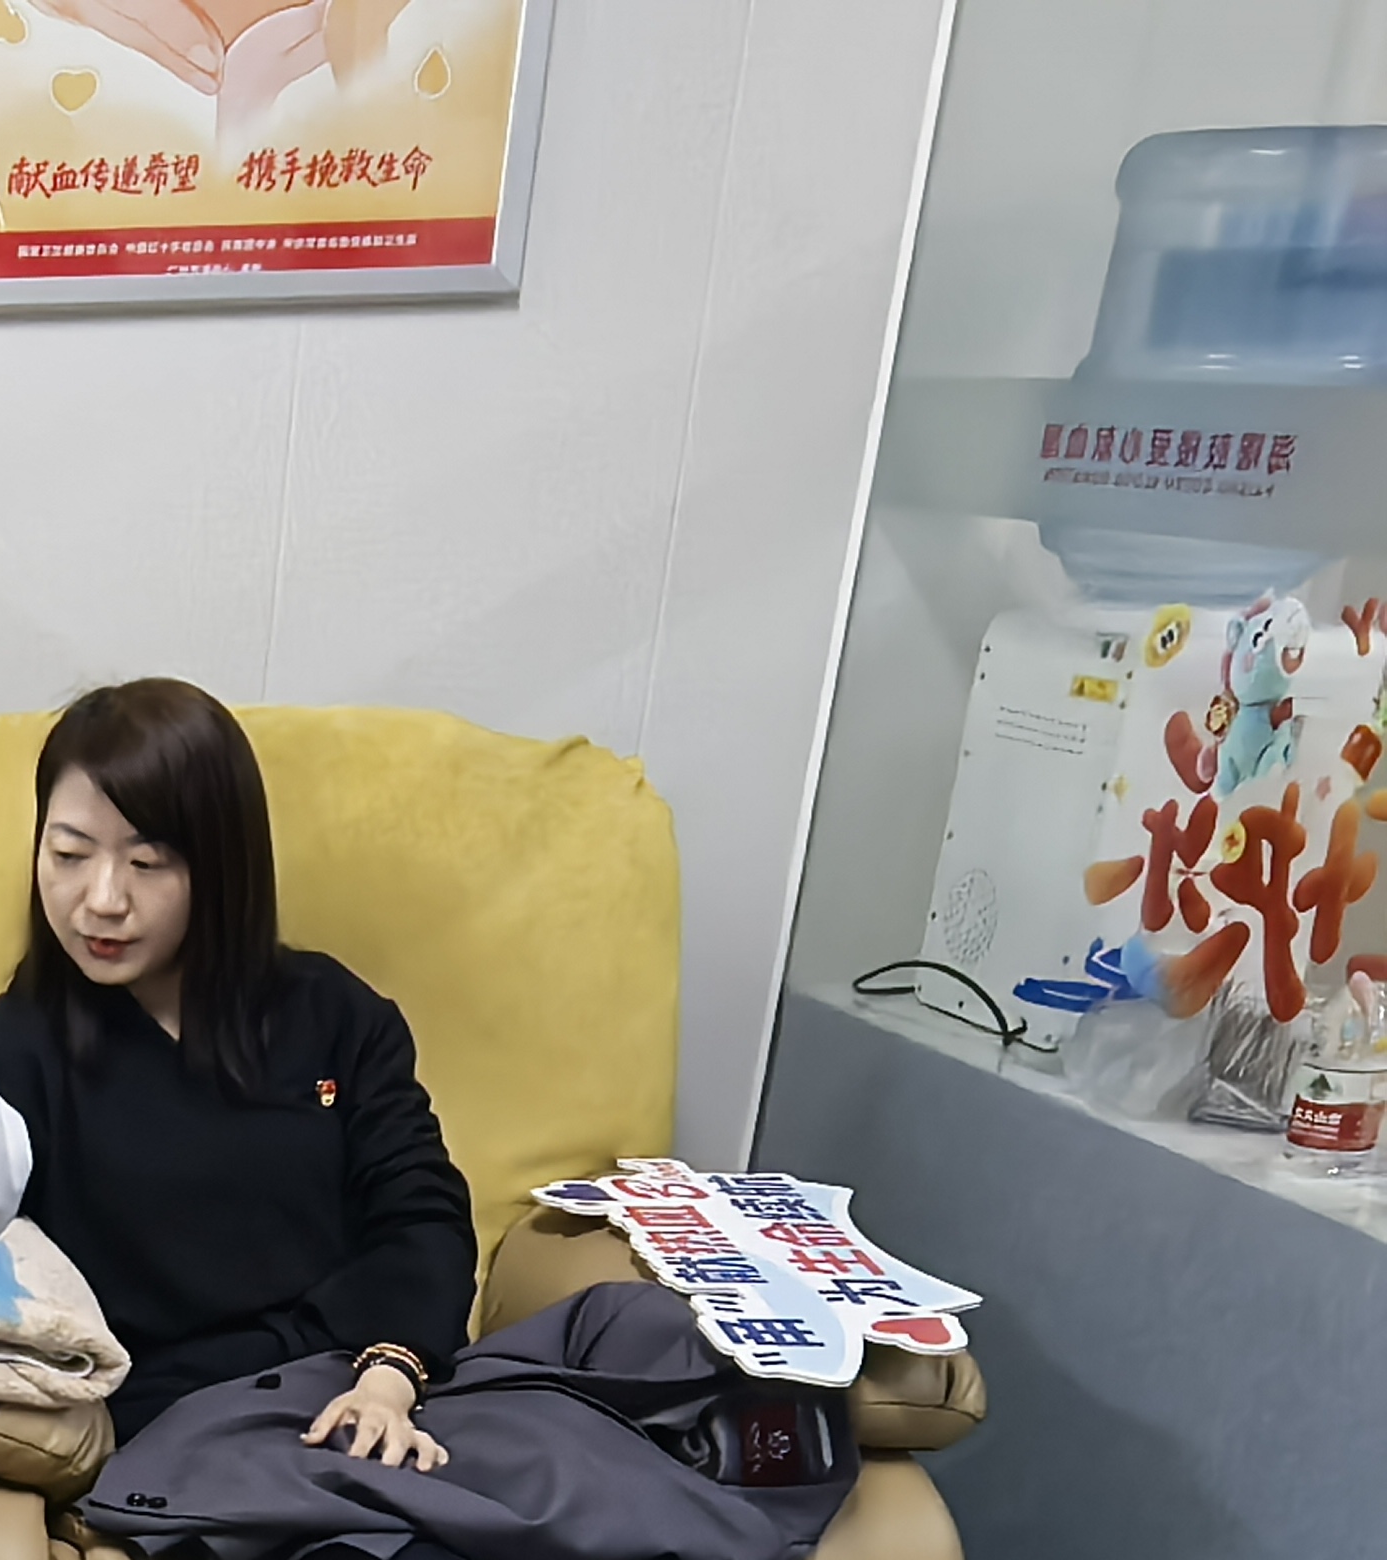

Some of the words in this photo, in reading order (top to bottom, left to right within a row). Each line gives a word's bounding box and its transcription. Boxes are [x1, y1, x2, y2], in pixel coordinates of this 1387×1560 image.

[7, 152, 200, 198] 献血传递希望
[235, 144, 433, 194] 携手挽救生命
